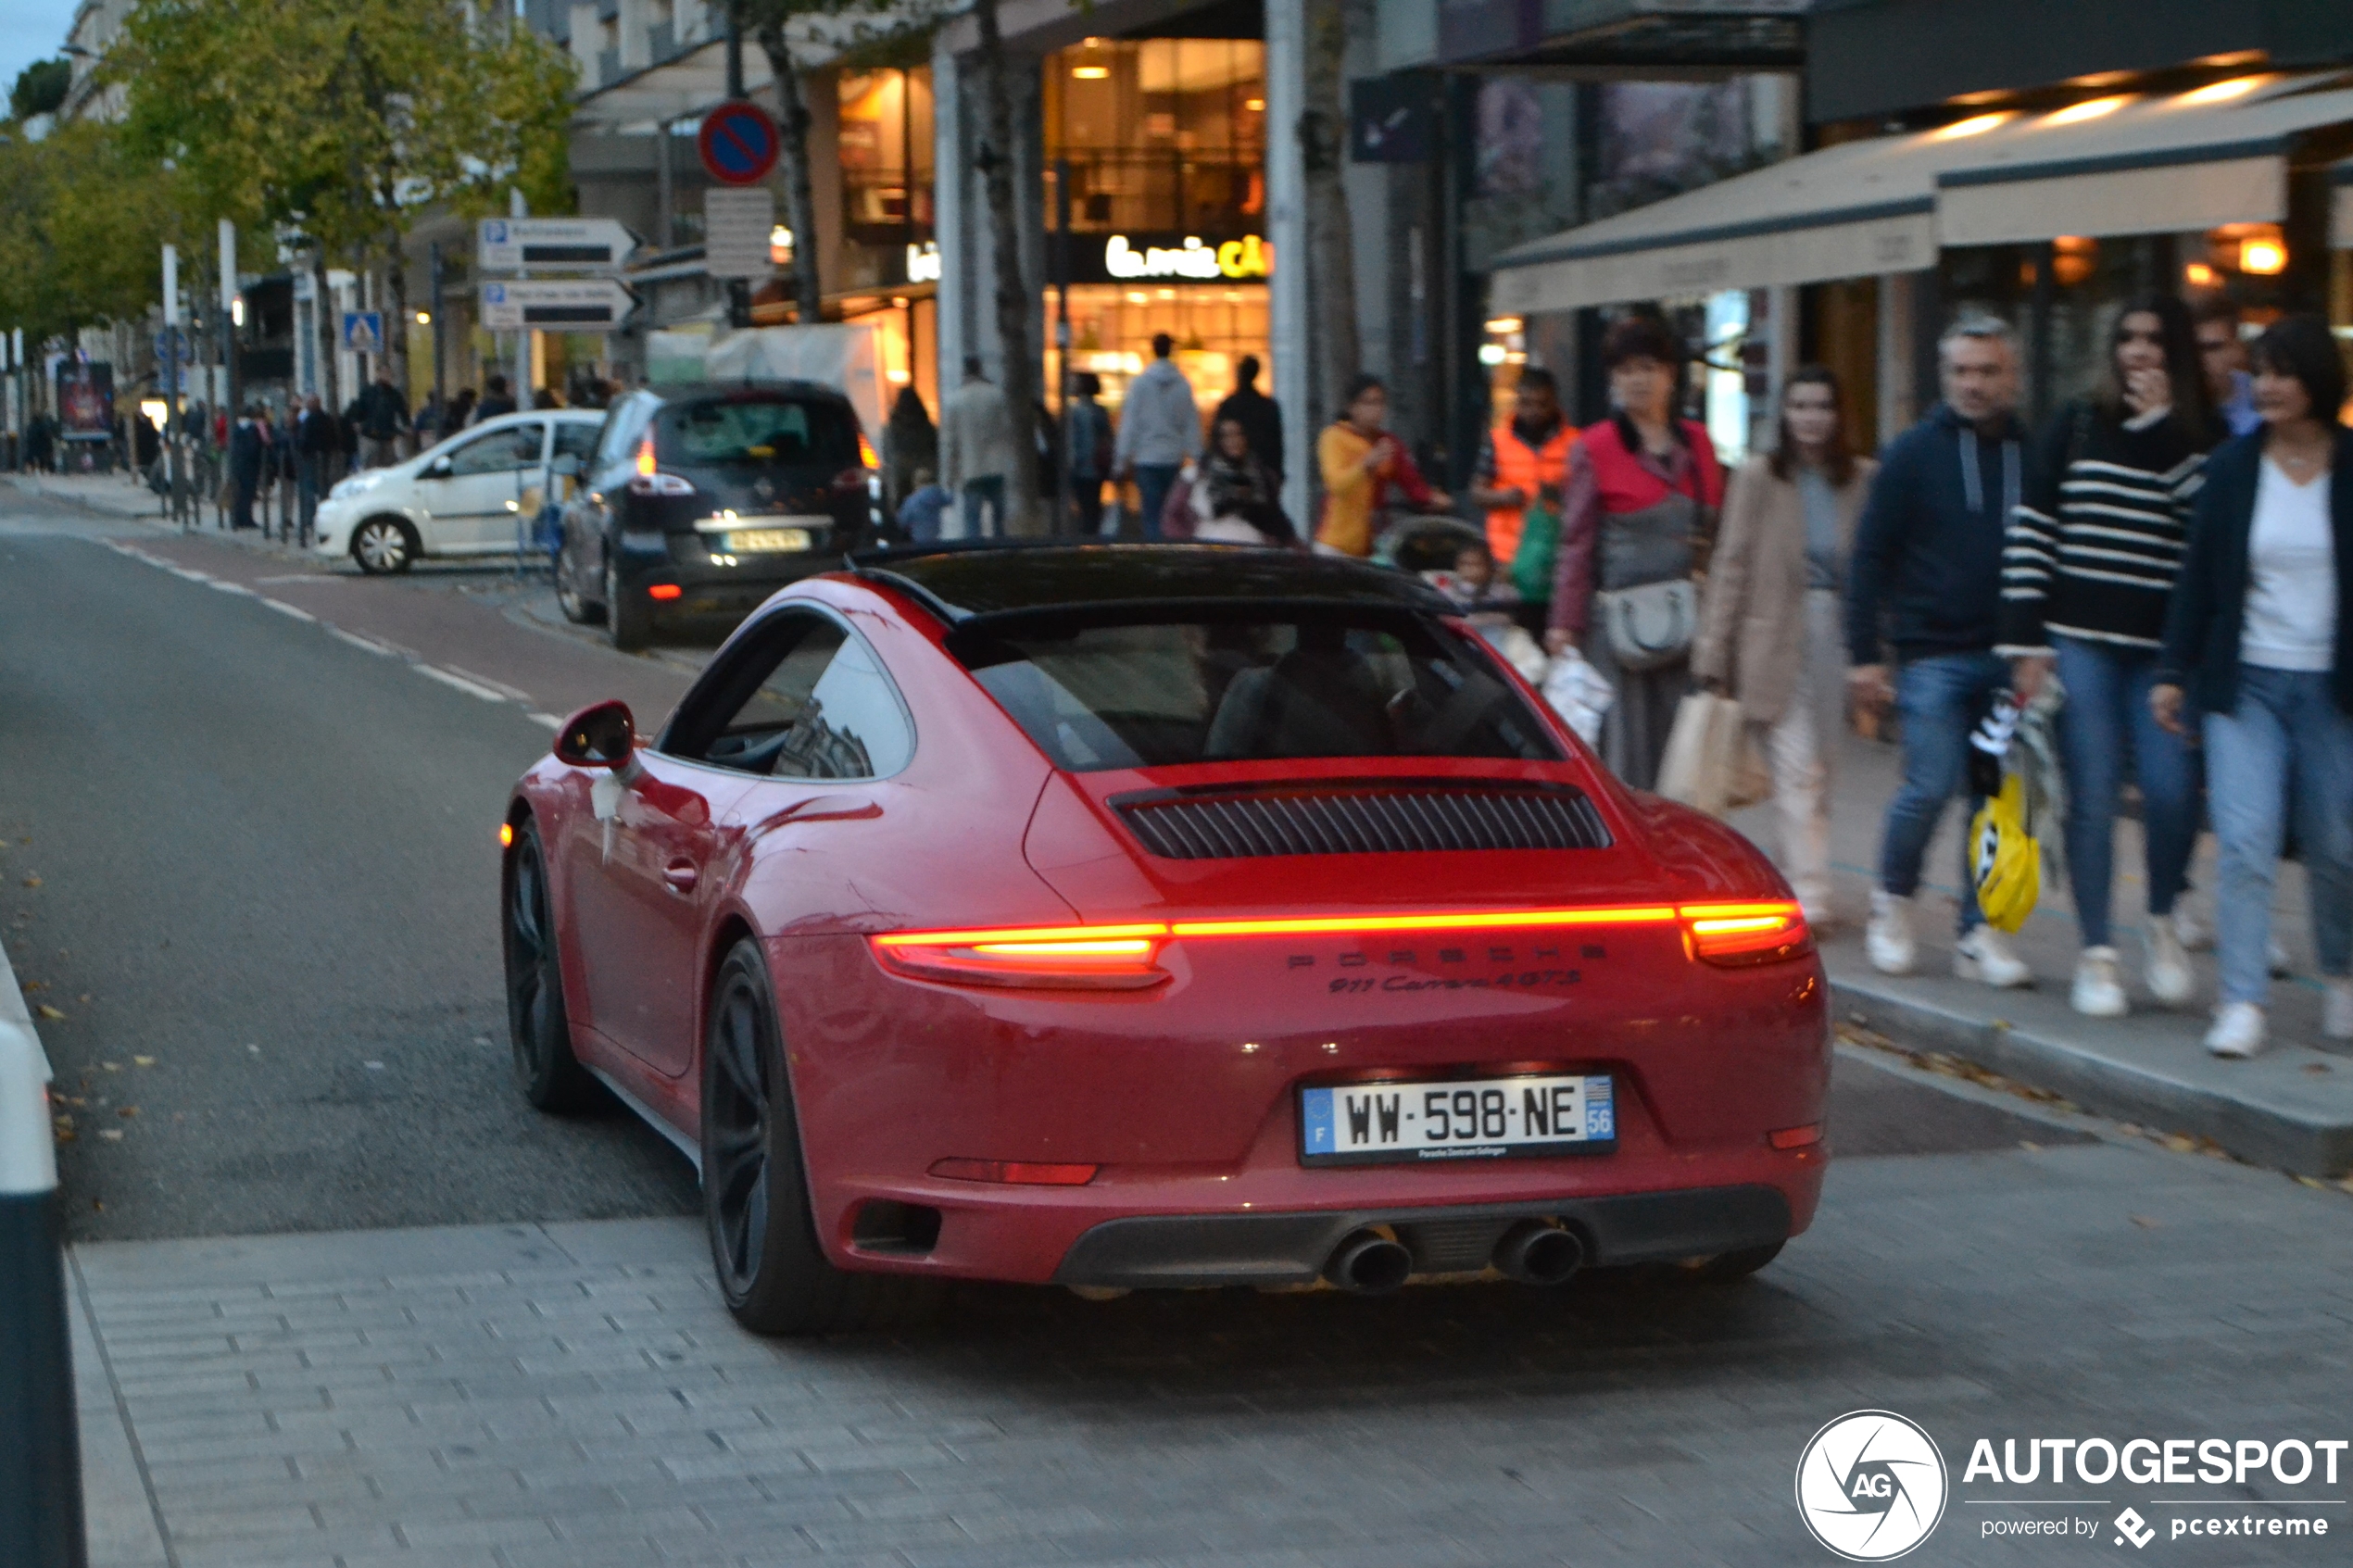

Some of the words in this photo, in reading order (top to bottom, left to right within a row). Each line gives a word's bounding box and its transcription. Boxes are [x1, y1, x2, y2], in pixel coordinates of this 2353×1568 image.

[1287, 945, 1606, 969] PORSCHE
[1328, 977, 1376, 993] 911
[1381, 975, 1491, 992] Carrera
[1588, 1110, 1612, 1134] 56
[1315, 1127, 1325, 1143] F
